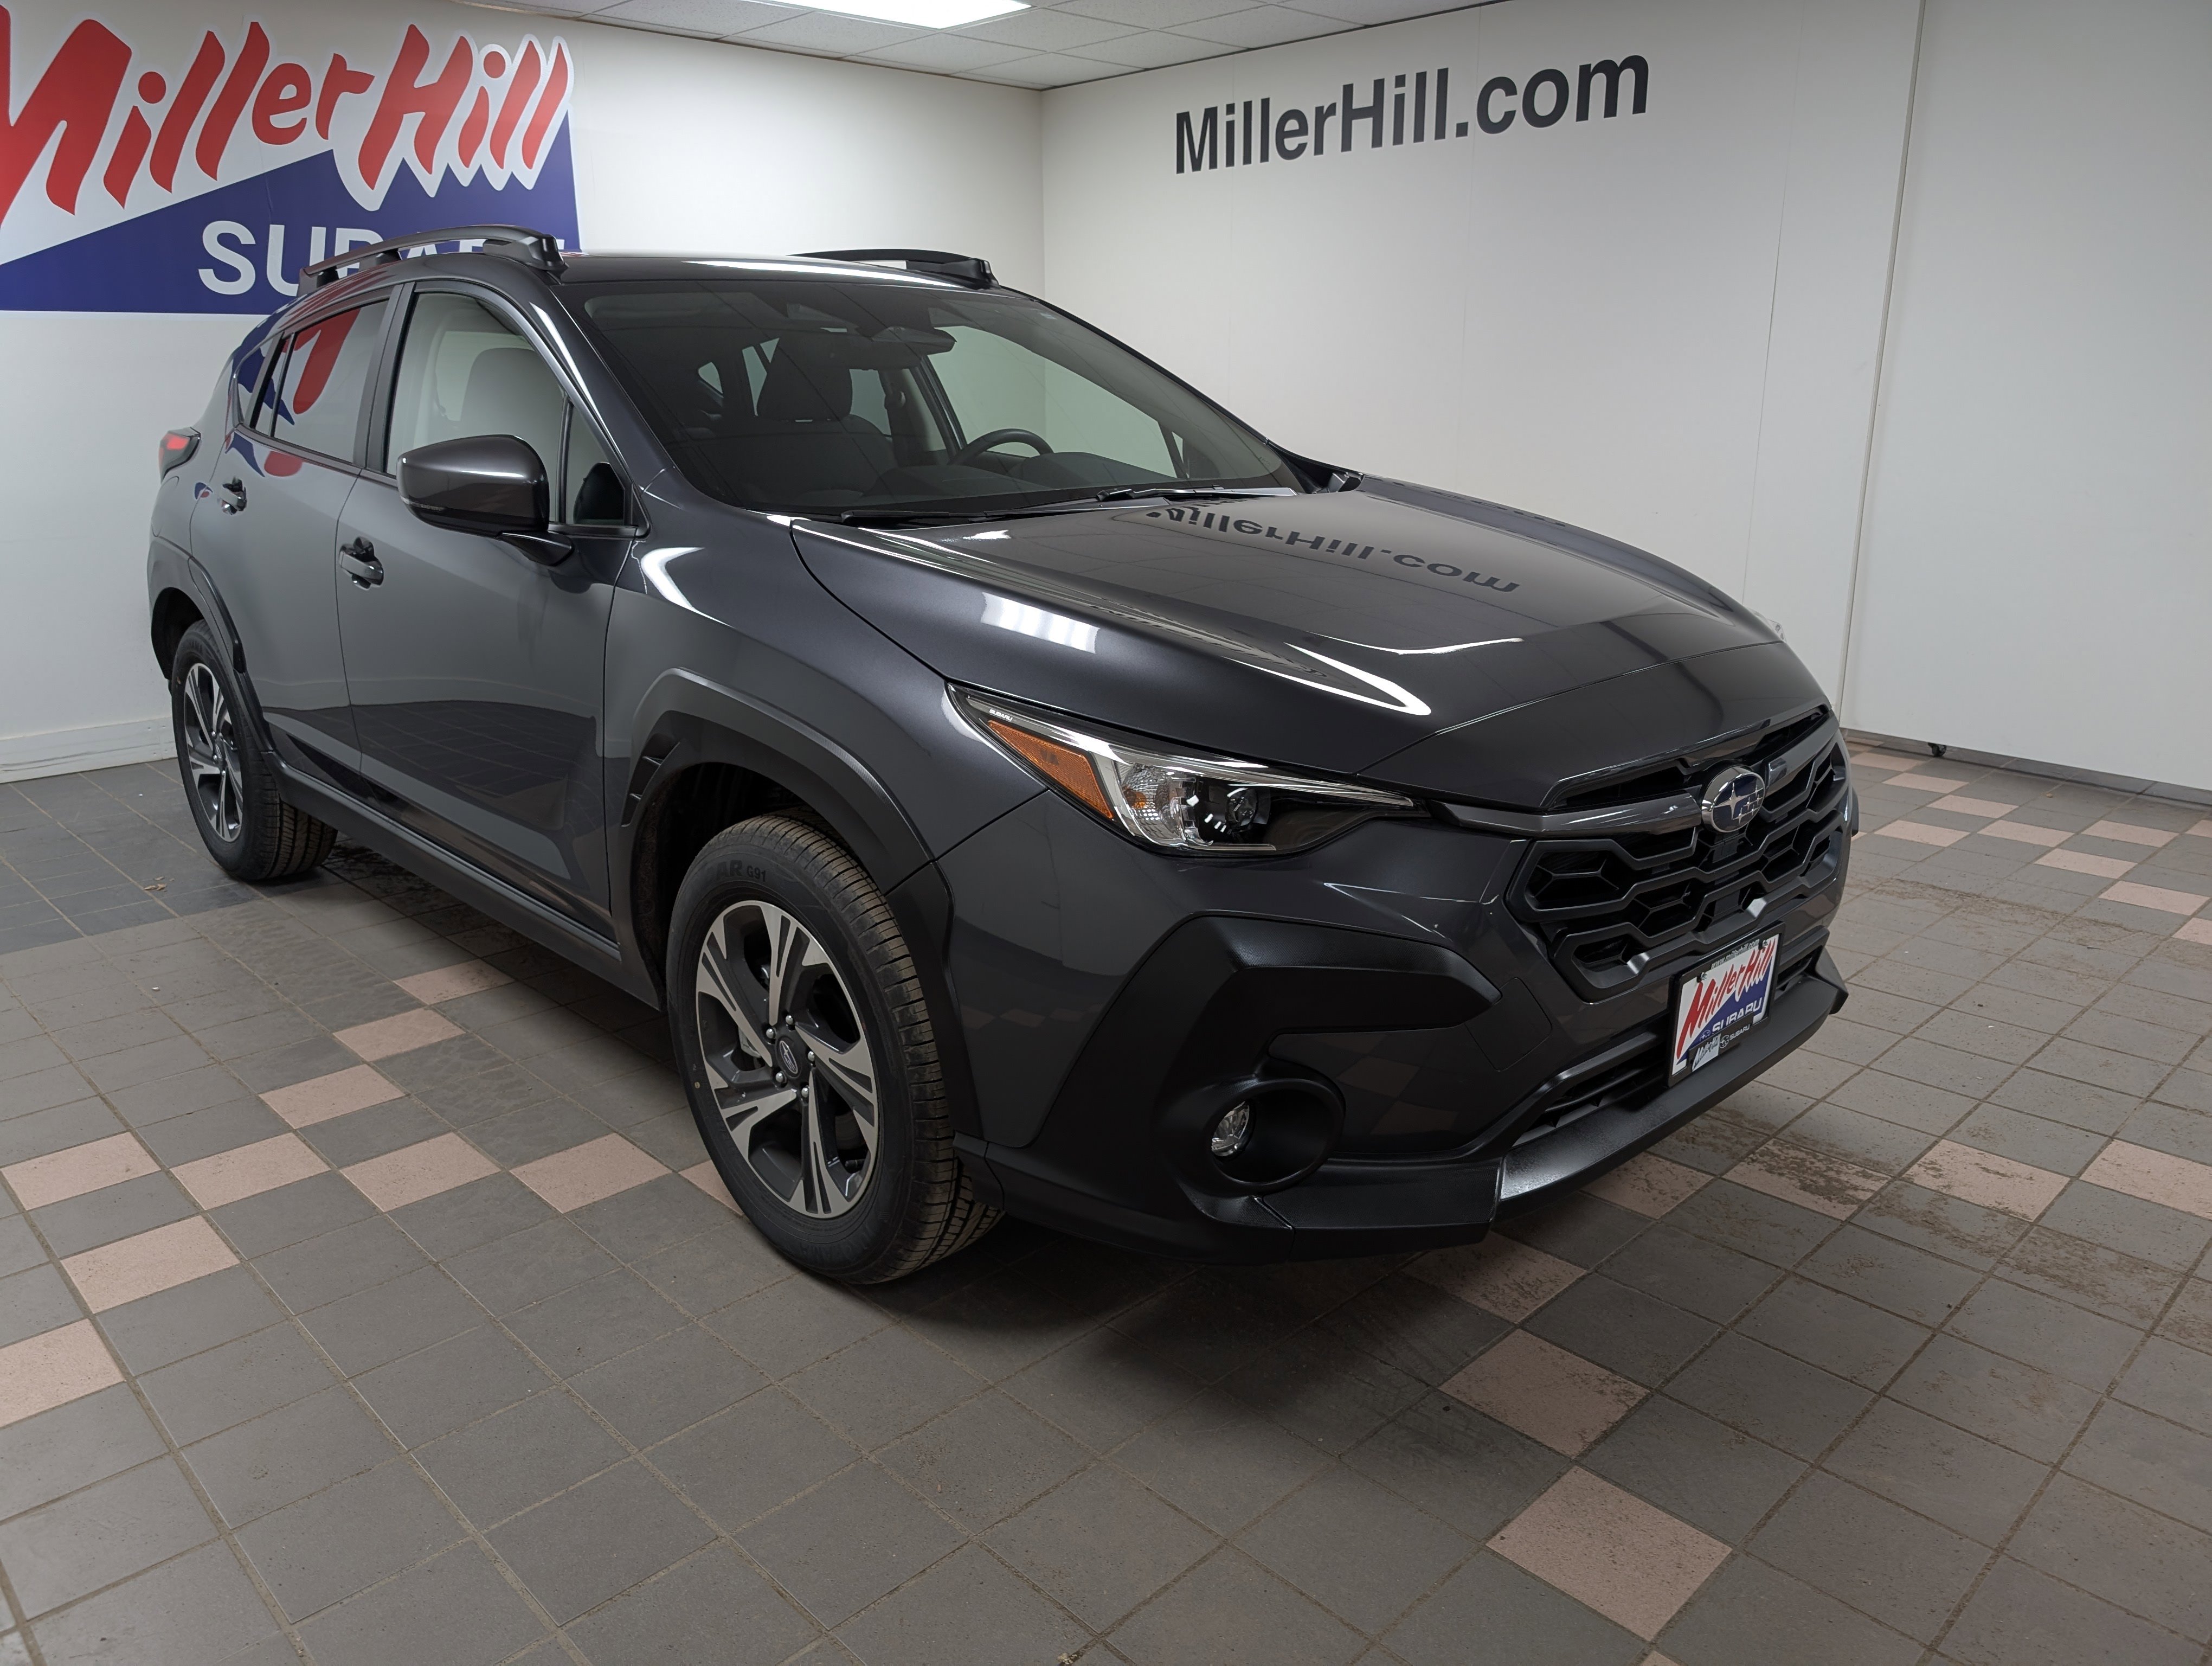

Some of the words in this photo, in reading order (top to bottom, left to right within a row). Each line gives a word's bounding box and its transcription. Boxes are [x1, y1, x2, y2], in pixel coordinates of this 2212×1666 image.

[1175, 55, 1649, 175] MillerHill.com
[989, 709, 1013, 721] SUBARU
[747, 865, 766, 882] G91
[1729, 1024, 1751, 1040] SUBARU
